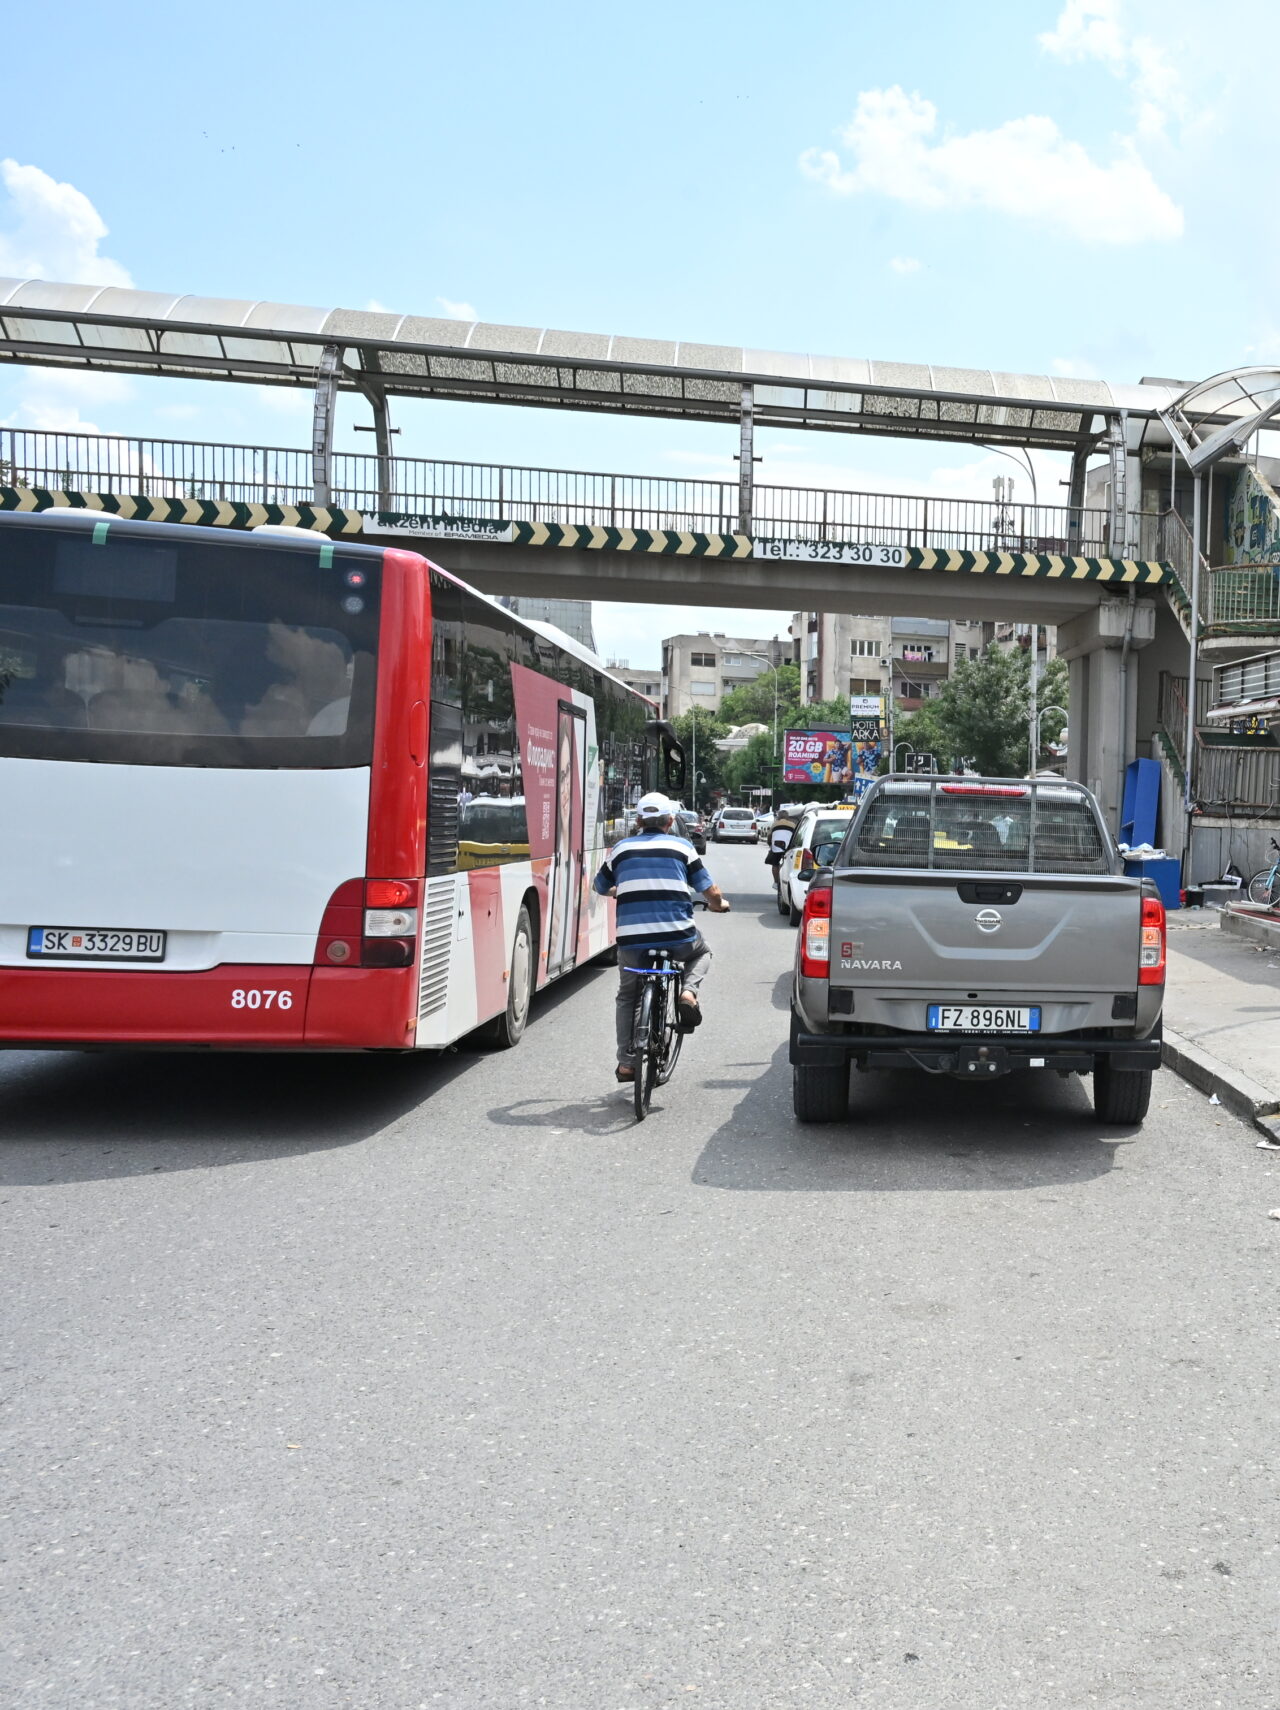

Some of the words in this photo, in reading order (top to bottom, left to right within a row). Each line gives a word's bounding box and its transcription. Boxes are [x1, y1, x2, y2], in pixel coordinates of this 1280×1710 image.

[444, 532, 499, 540] EPAMEDIA
[757, 540, 800, 558] Tel.:
[808, 543, 843, 560] 323
[850, 546, 873, 562] 30
[880, 548, 903, 564] 30
[852, 720, 878, 730] HOTEL
[852, 729, 880, 740] ARKA
[788, 740, 804, 752] 20
[806, 741, 823, 753] GB
[44, 932, 69, 951] SK
[84, 933, 133, 952] 3329
[136, 934, 160, 953] BU
[841, 959, 903, 970] NAVARA
[231, 989, 293, 1010] 8076
